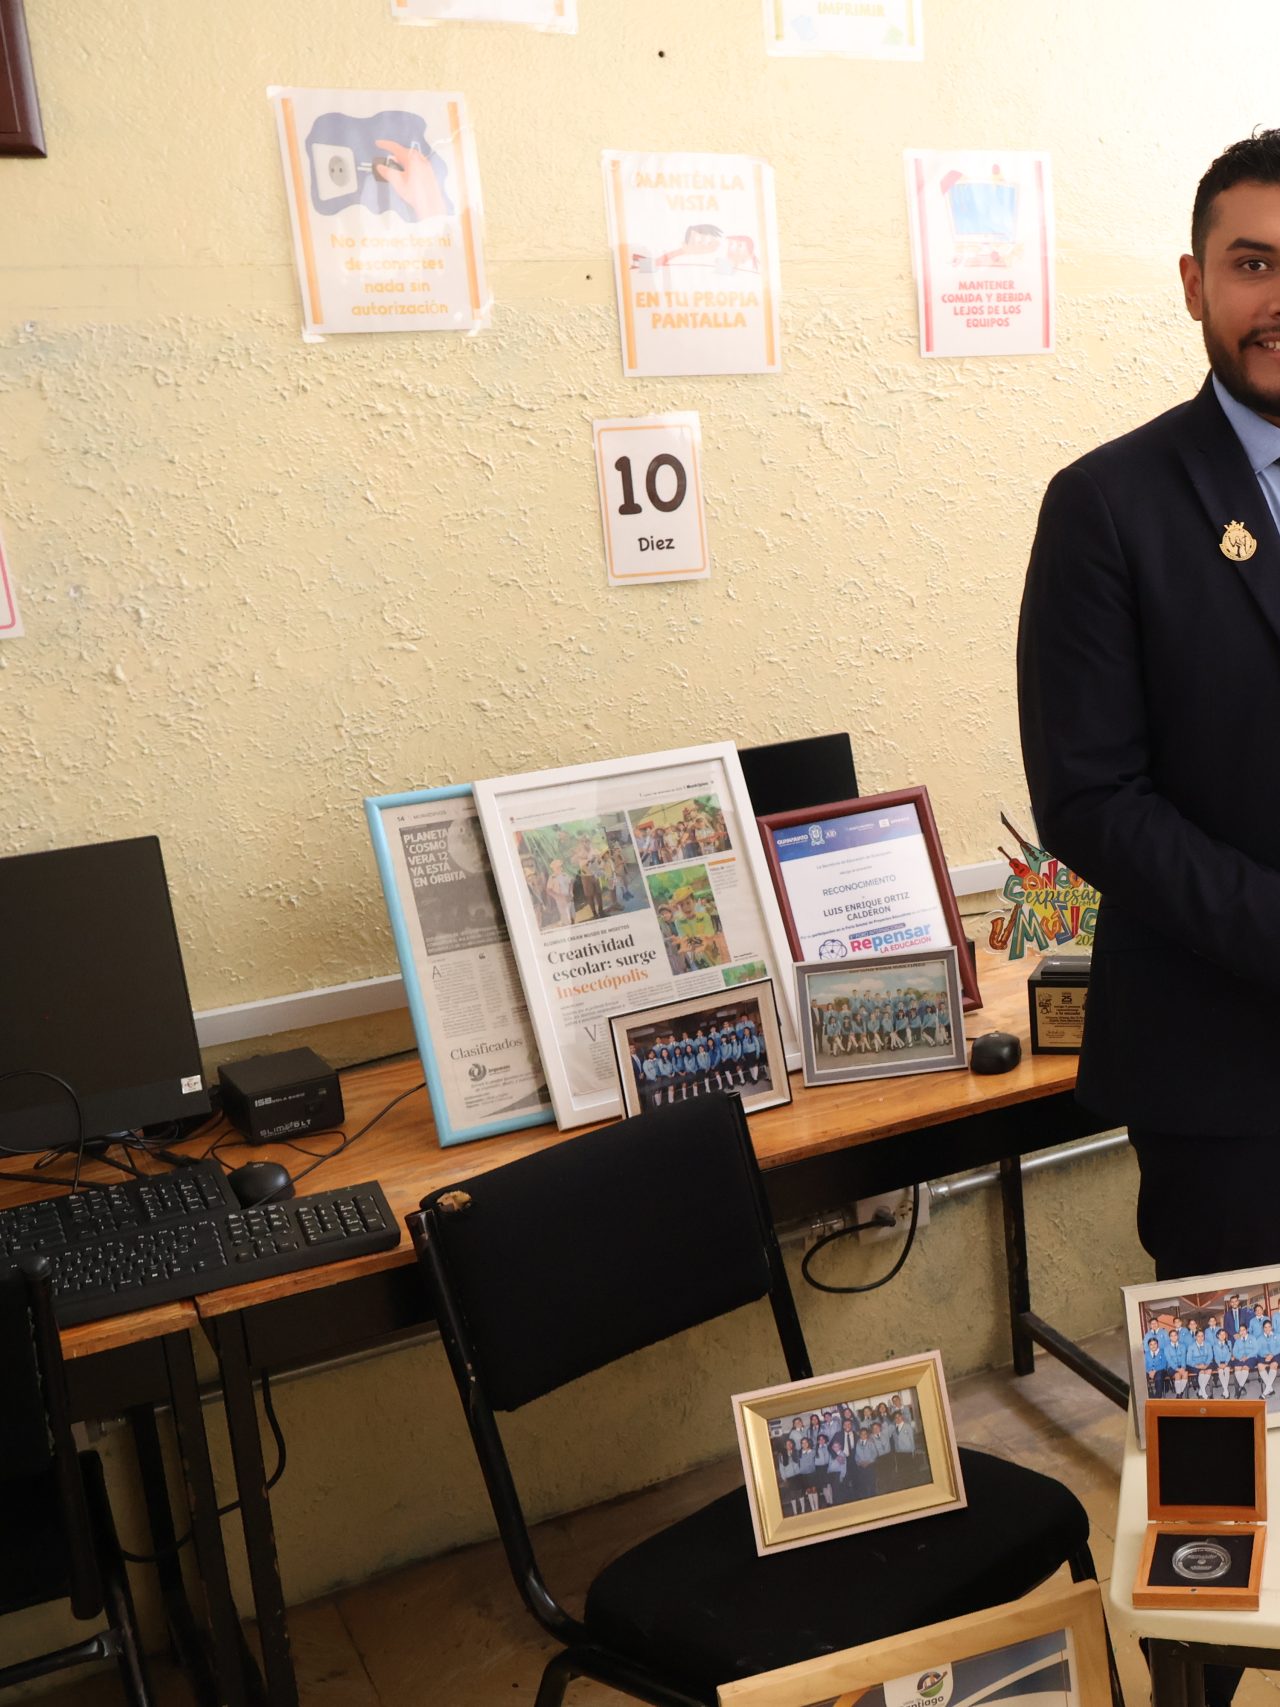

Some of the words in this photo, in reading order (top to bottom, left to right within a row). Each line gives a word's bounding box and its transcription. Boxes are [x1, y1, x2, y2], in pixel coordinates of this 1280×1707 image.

[636, 170, 716, 190] MANTÉN
[720, 174, 745, 191] LA
[666, 195, 719, 211] VISTA
[330, 234, 356, 248] No
[438, 233, 452, 247] ni
[364, 280, 405, 294] nada
[410, 280, 431, 292] sin
[958, 280, 1015, 290] MANTENER
[635, 291, 660, 308] EN
[665, 291, 689, 308] TU
[693, 290, 759, 308] PROPIA
[941, 293, 983, 303] COMIDA
[986, 293, 994, 302] Y
[996, 292, 1032, 302] BEBIDA
[352, 301, 449, 316] autorización
[953, 305, 985, 315] LEJOS
[988, 305, 1000, 315] DE
[1002, 304, 1022, 314] LOS
[651, 311, 747, 329] PANTALLA
[966, 317, 1010, 328] EQUIPOS
[614, 453, 687, 515] 10
[638, 536, 675, 552] Diez
[408, 853, 436, 866] VERA
[437, 852, 449, 861] 12
[410, 866, 425, 876] YA
[425, 860, 451, 874] ESTÁ
[413, 877, 428, 887] EN
[823, 874, 896, 896] RECONOCIMIENTO
[823, 906, 843, 917] LUIS
[845, 898, 882, 913] ENRIQUE
[884, 892, 910, 904] ORTIZ
[850, 924, 931, 953] Repensar
[547, 934, 635, 964] Creatividad
[880, 946, 889, 954] LA
[552, 961, 612, 981] escolar:
[616, 950, 656, 965] surge
[450, 1038, 523, 1060] Clasificados
